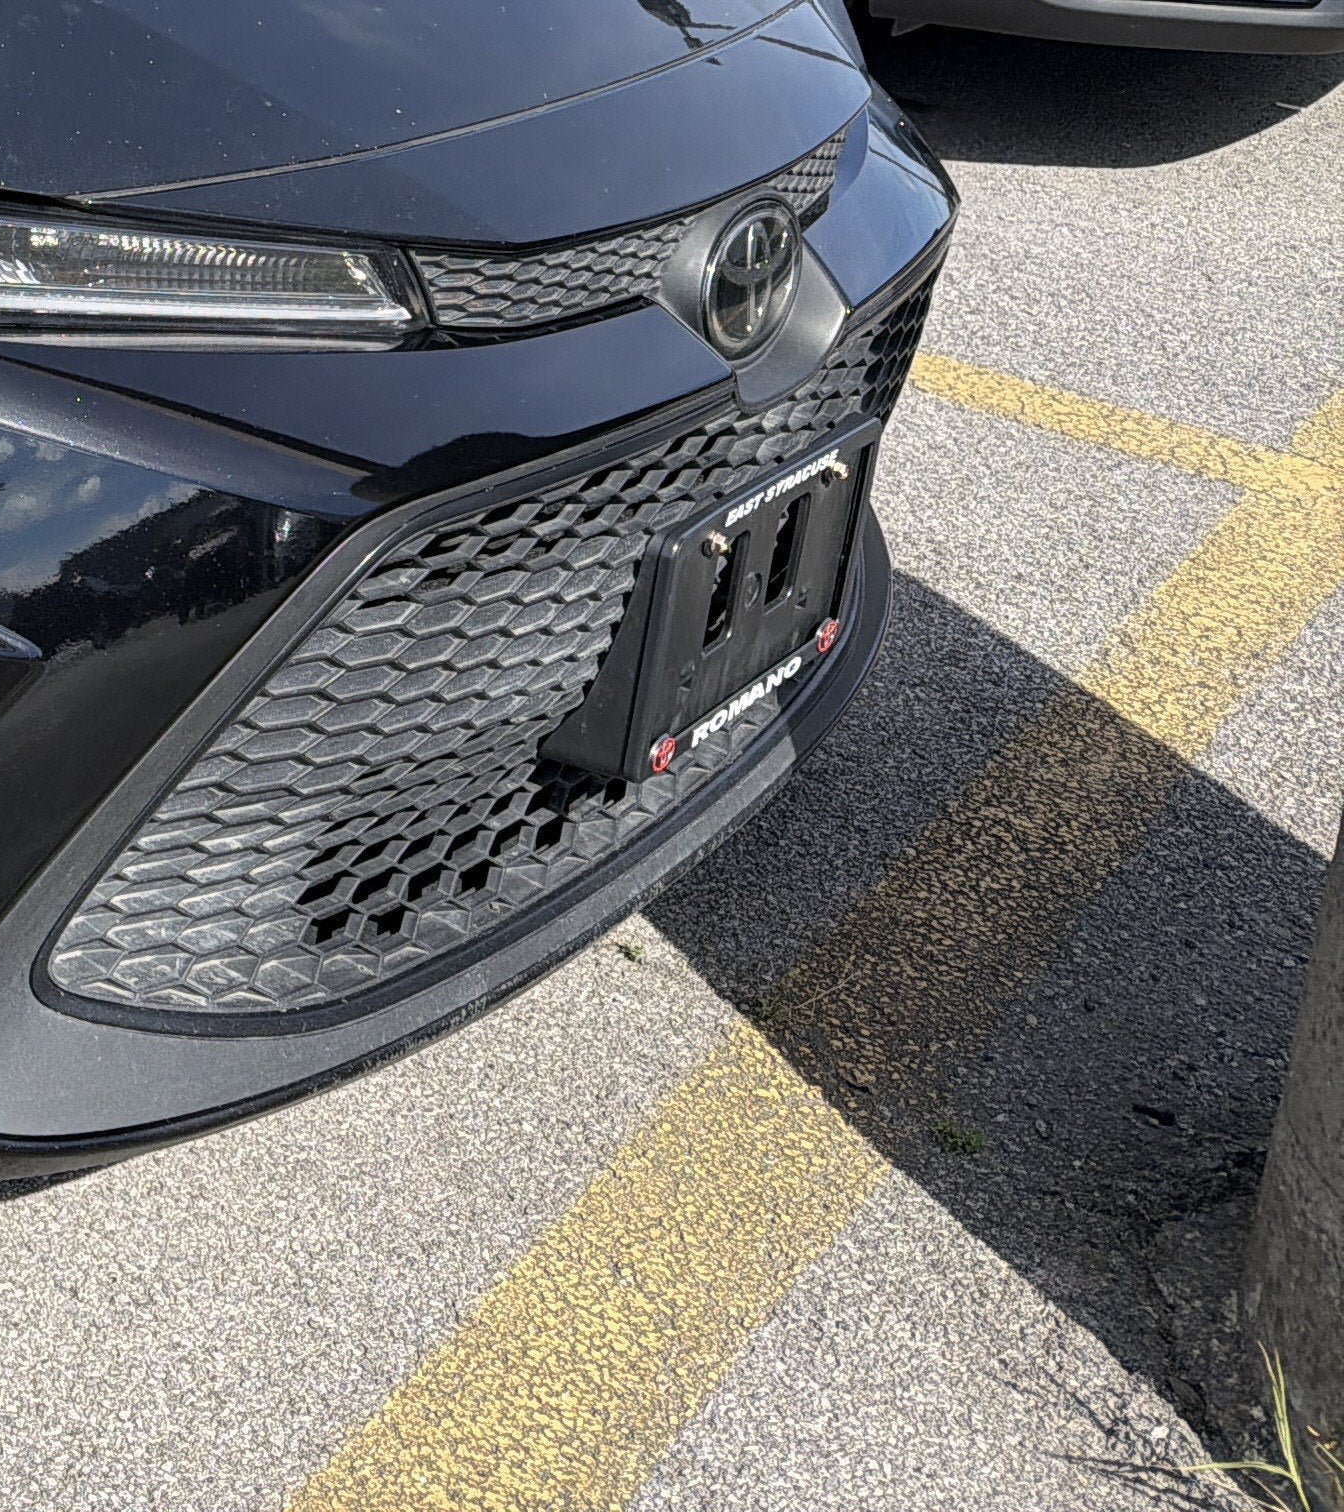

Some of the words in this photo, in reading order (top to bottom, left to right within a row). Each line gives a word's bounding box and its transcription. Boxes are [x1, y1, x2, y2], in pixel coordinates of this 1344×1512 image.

[724, 491, 765, 528] EAST
[764, 448, 840, 503] SYRACUSE
[690, 655, 803, 748] ROMANO
